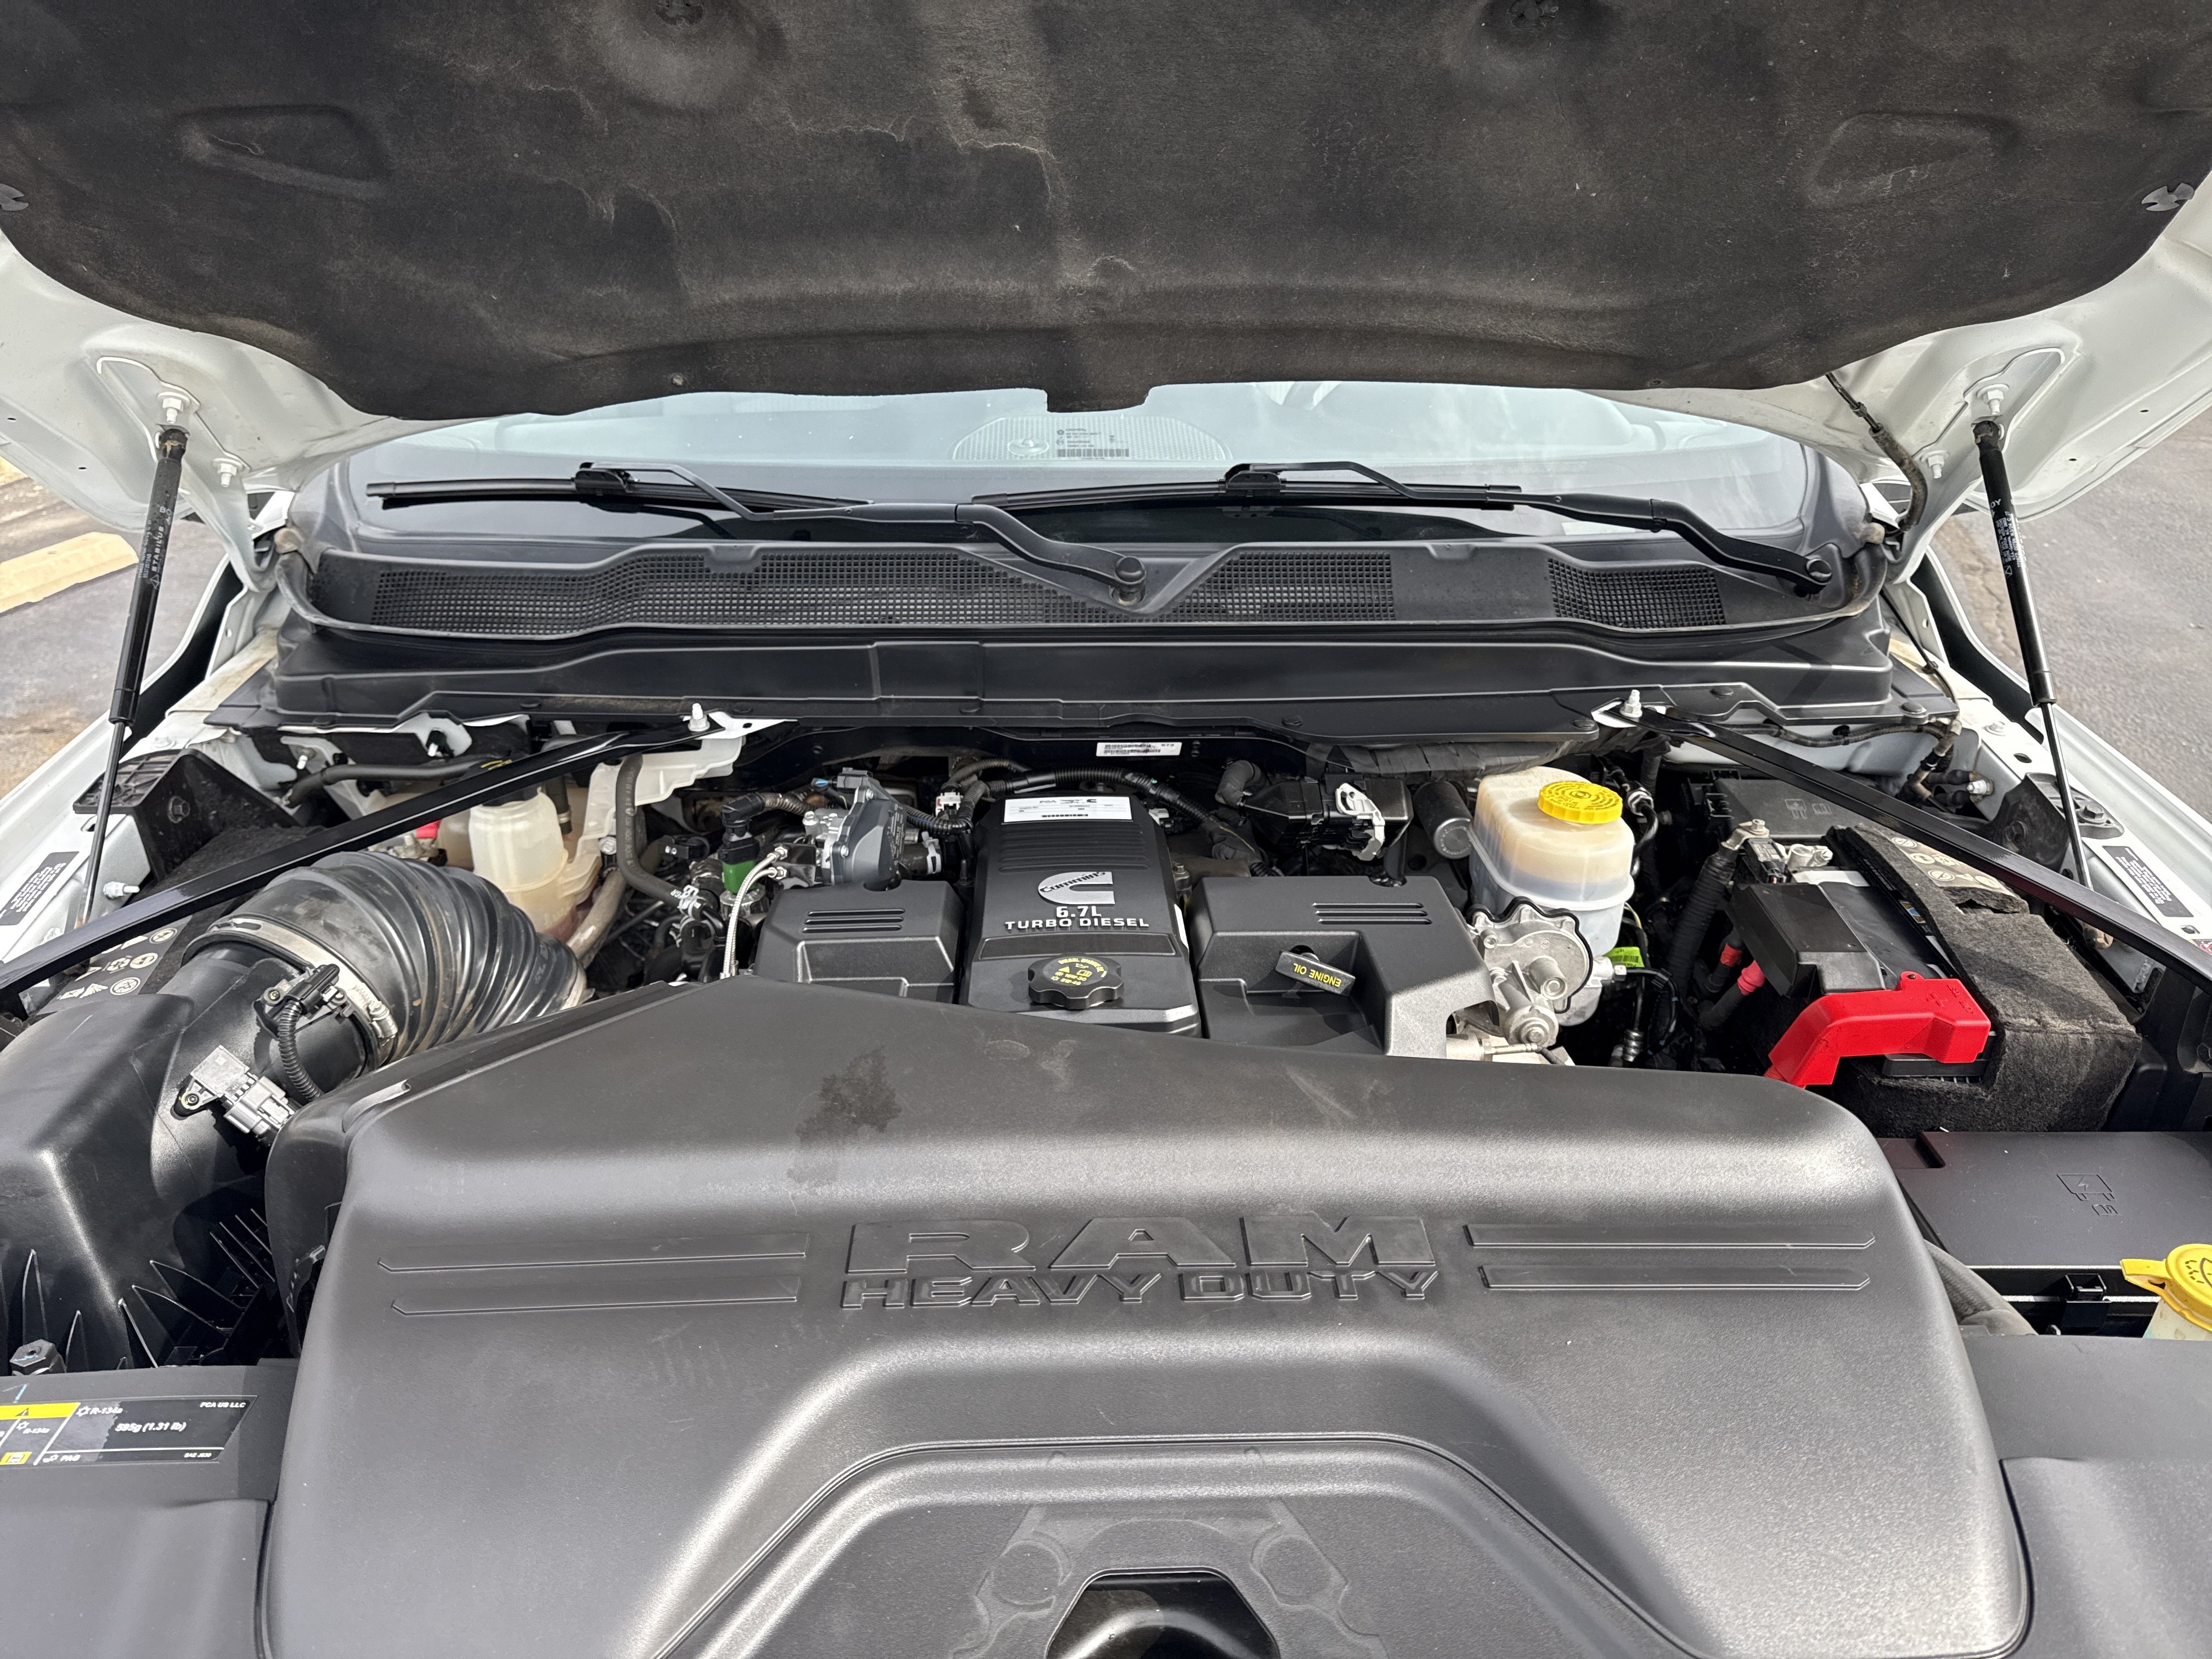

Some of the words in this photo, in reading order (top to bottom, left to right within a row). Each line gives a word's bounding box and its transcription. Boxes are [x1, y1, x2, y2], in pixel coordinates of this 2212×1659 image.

[151, 526, 165, 572] STABILUS
[1040, 871, 1106, 893] Cummins
[1056, 905, 1102, 918] 6.7L
[1005, 918, 1072, 930] TURBO
[1079, 918, 1150, 928] DIESEL
[1293, 963, 1307, 975] OIL
[1308, 969, 1342, 988] ENGINE
[845, 1216, 1436, 1274] RAM
[841, 1273, 1161, 1310] HEAVY
[1178, 1270, 1439, 1302] DUTY
